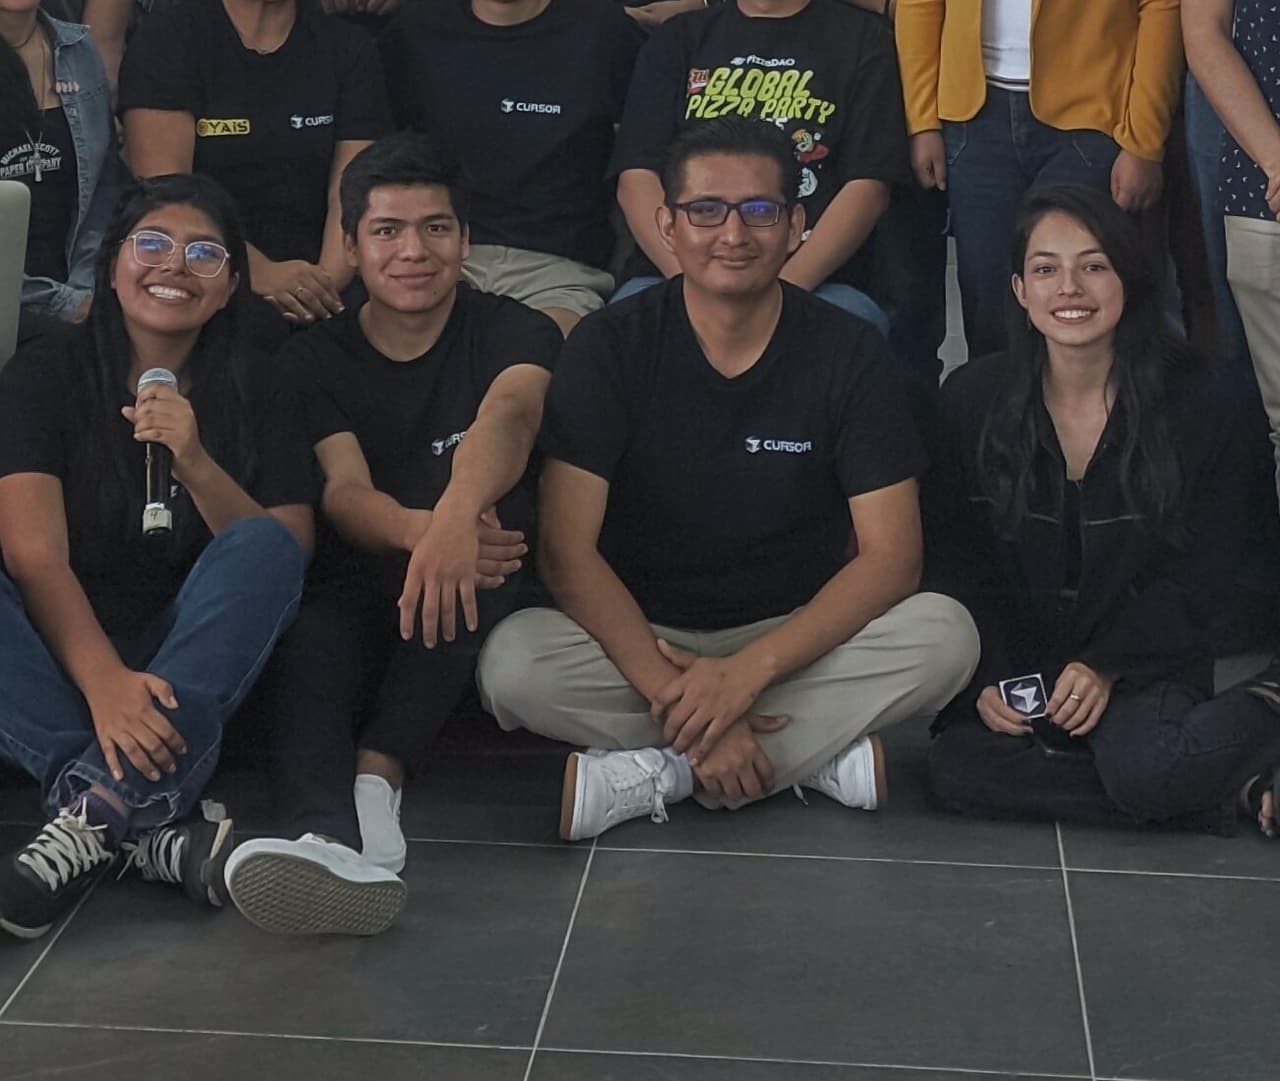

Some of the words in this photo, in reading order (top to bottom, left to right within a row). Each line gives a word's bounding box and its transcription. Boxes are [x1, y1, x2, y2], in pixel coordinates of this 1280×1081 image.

[704, 67, 814, 102] GLOBAL
[516, 102, 561, 114] CURSOR
[685, 94, 756, 120] PIZZA
[760, 96, 836, 124] PARTY
[763, 440, 812, 453] CURSOR
